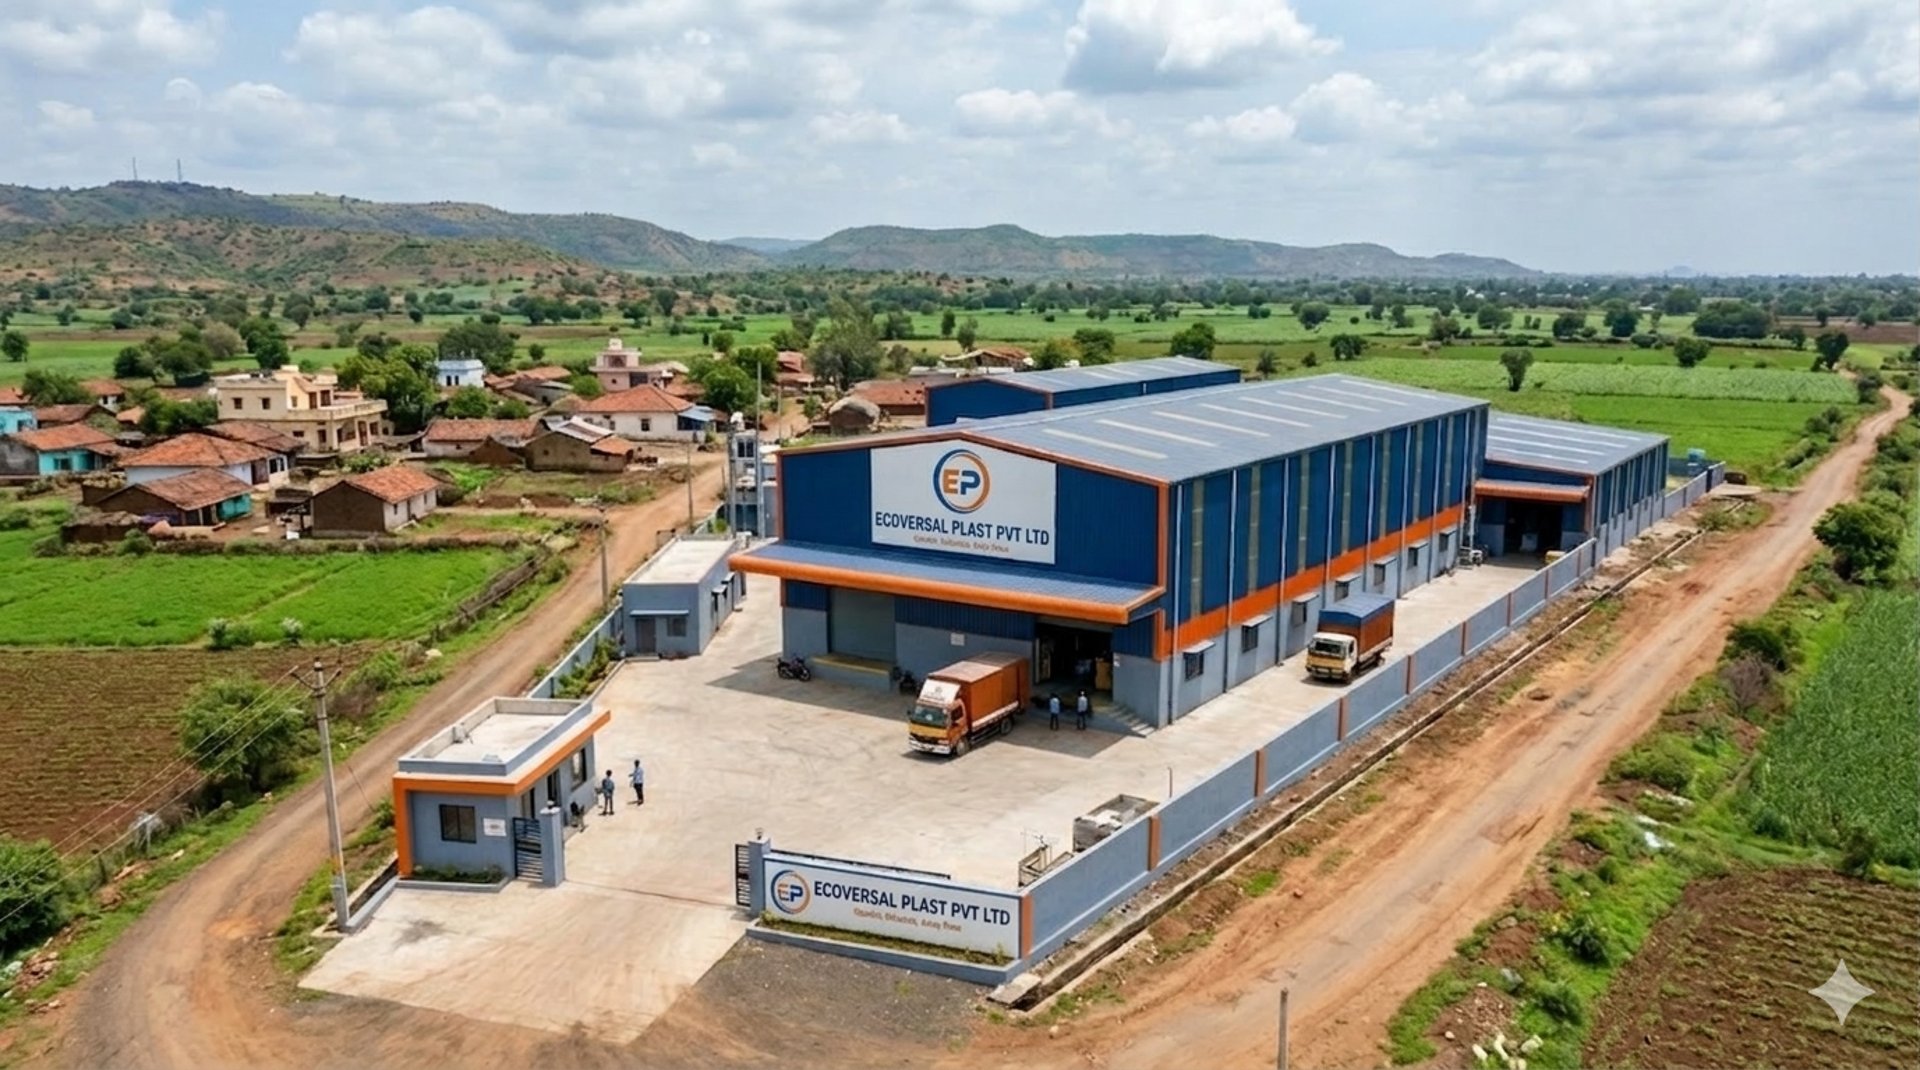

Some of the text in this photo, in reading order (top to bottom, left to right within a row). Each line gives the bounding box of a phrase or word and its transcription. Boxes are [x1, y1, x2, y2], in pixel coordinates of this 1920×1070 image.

[942, 469, 981, 495] EP
[875, 511, 948, 534] ECOVERSAL
[952, 520, 993, 539] PLAST
[996, 525, 1022, 542] PVT
[1026, 528, 1049, 546] LTD
[777, 883, 804, 902] EP
[814, 881, 897, 908] ECOVERSAL
[901, 894, 947, 916] PLAST
[951, 902, 980, 921] PVT
[983, 908, 1011, 926] LTD
